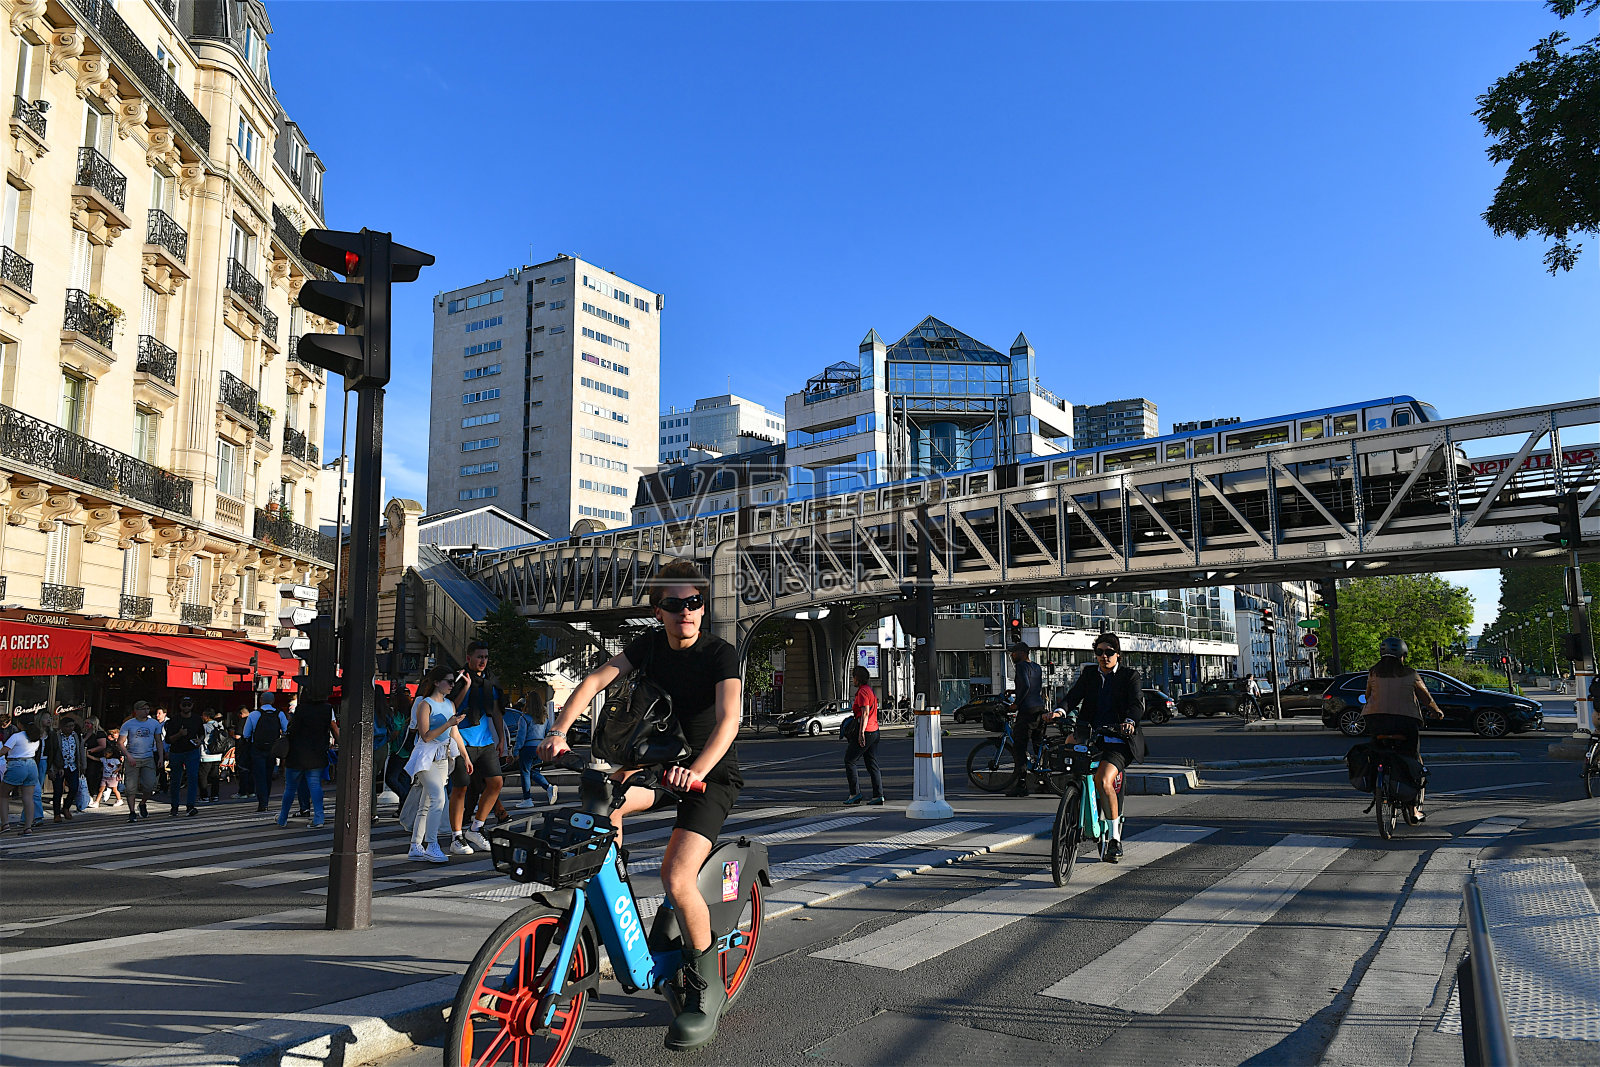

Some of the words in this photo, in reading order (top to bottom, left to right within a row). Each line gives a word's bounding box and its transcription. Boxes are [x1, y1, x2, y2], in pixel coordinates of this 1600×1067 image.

[25, 613, 70, 626] RISTORANTE
[10, 634, 50, 650] CREPES
[11, 656, 64, 670] BREAKFAST
[614, 895, 642, 951] dott
